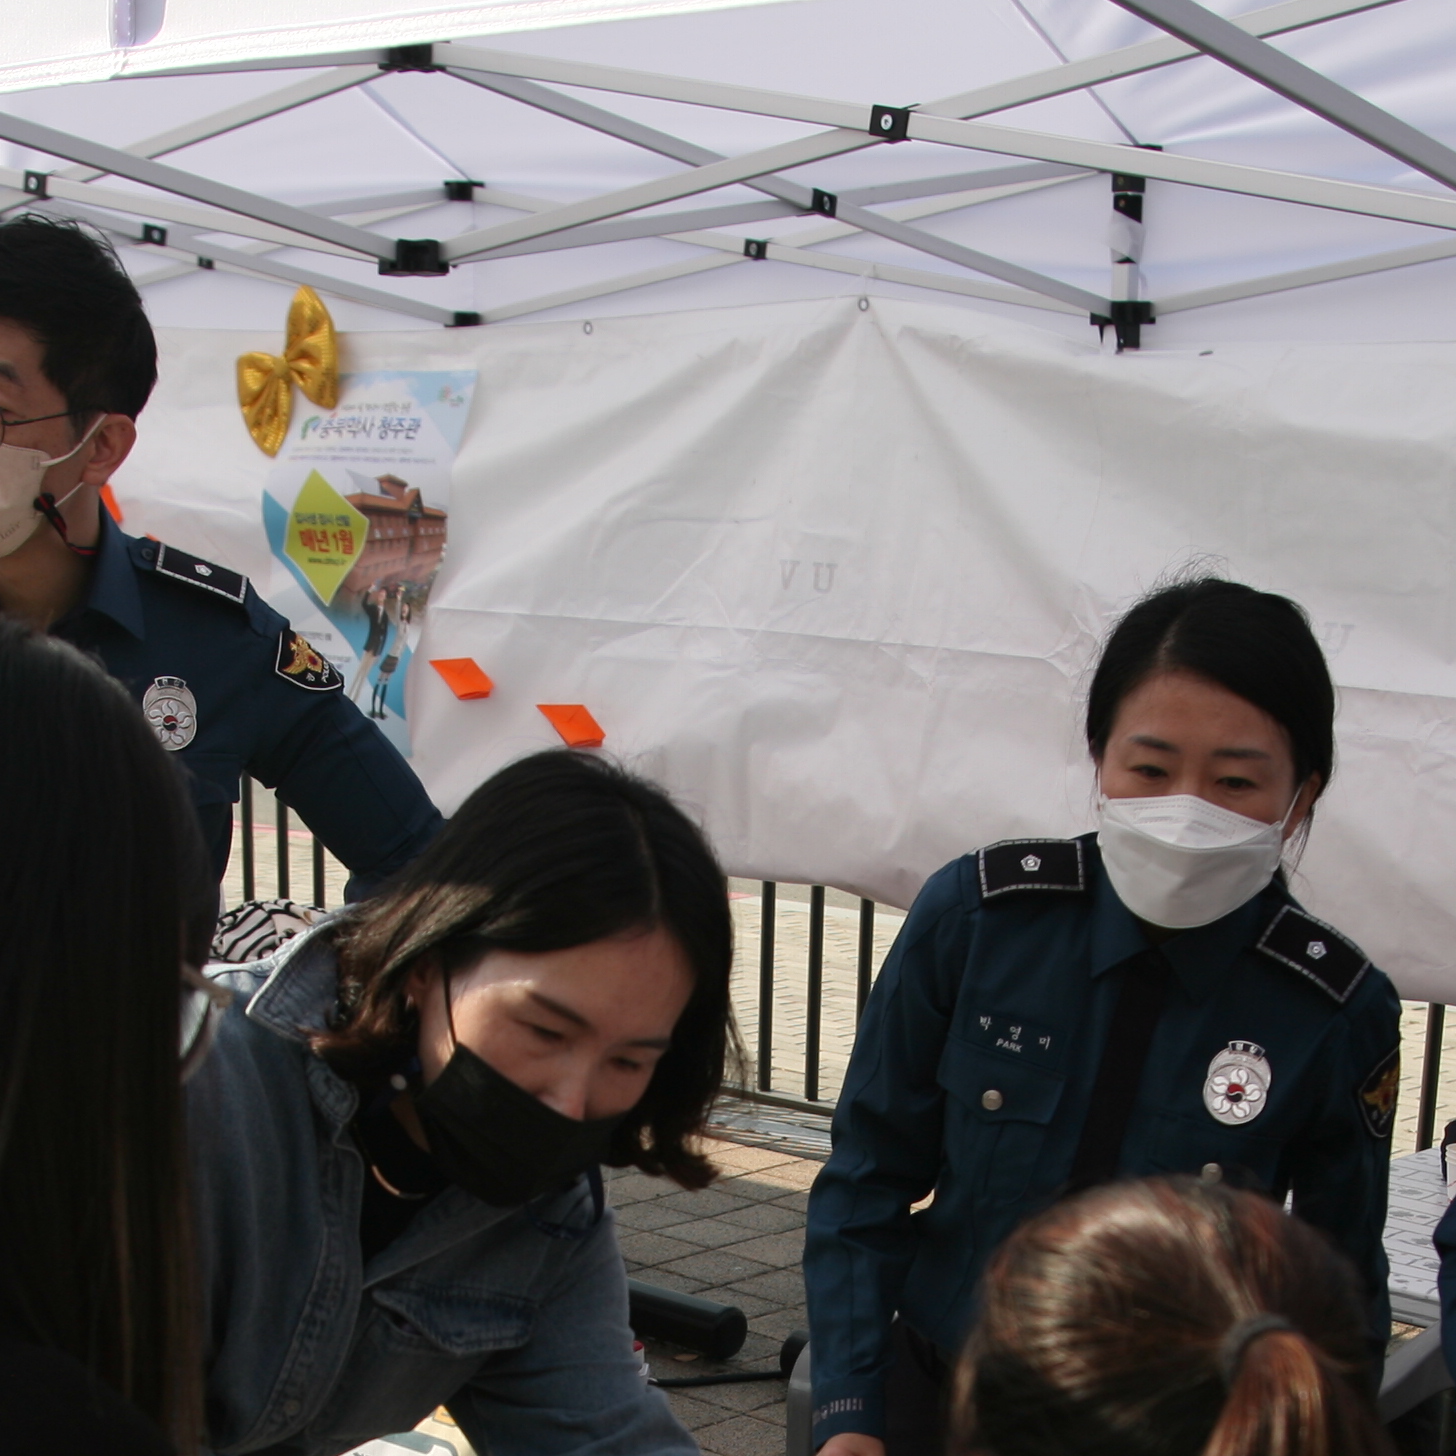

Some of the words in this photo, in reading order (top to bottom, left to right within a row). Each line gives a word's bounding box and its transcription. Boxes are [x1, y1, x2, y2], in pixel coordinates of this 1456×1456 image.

[377, 416, 422, 440] 청주관
[299, 528, 330, 552] 매년
[332, 529, 354, 554] 1월
[996, 1038, 1023, 1053] PARK
